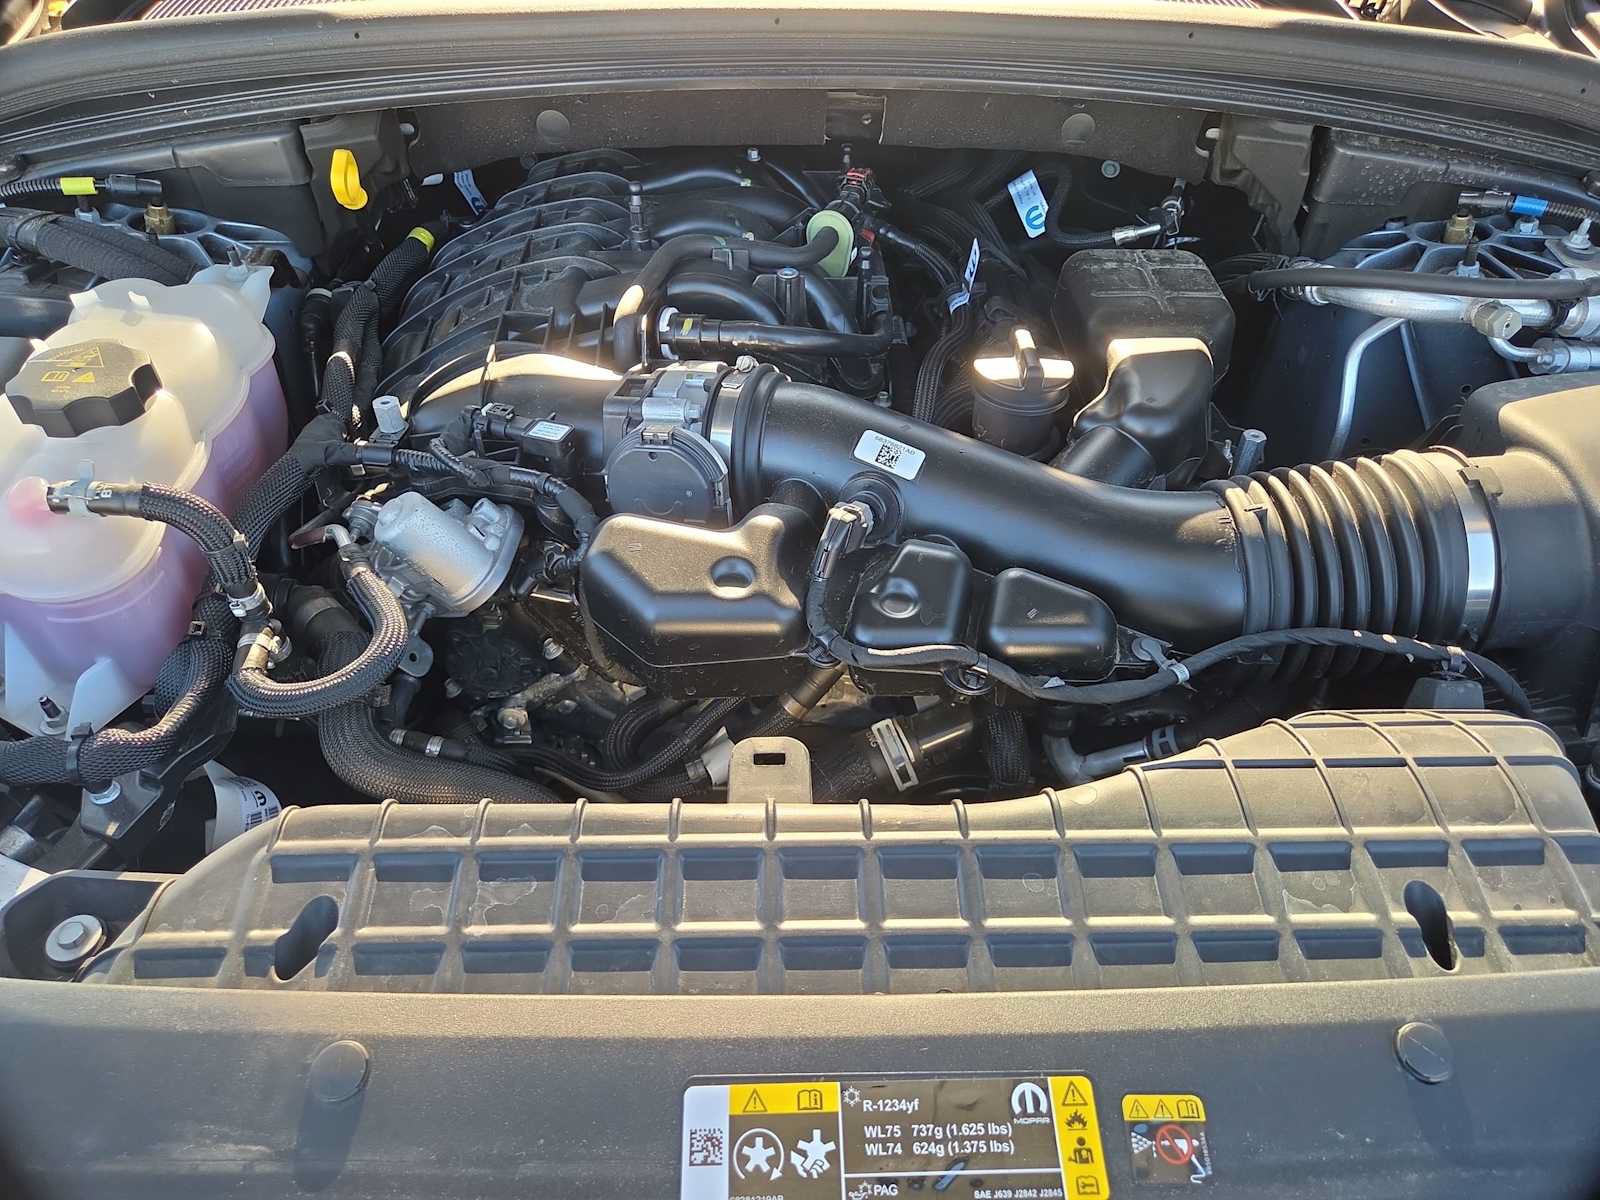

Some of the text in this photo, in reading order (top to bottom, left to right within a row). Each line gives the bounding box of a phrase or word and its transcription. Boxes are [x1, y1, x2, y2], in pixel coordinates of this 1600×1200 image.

[863, 1098, 920, 1114] R-1234yf
[1014, 1117, 1050, 1125] MOPAR
[864, 1122, 1012, 1139] WL75 737g (1.625 lbs)
[865, 1140, 1015, 1157] WL74 624g (1.375 lbs)
[873, 1184, 898, 1196] PAG
[974, 1190, 992, 1199] SAE
[993, 1189, 1013, 1198] J639
